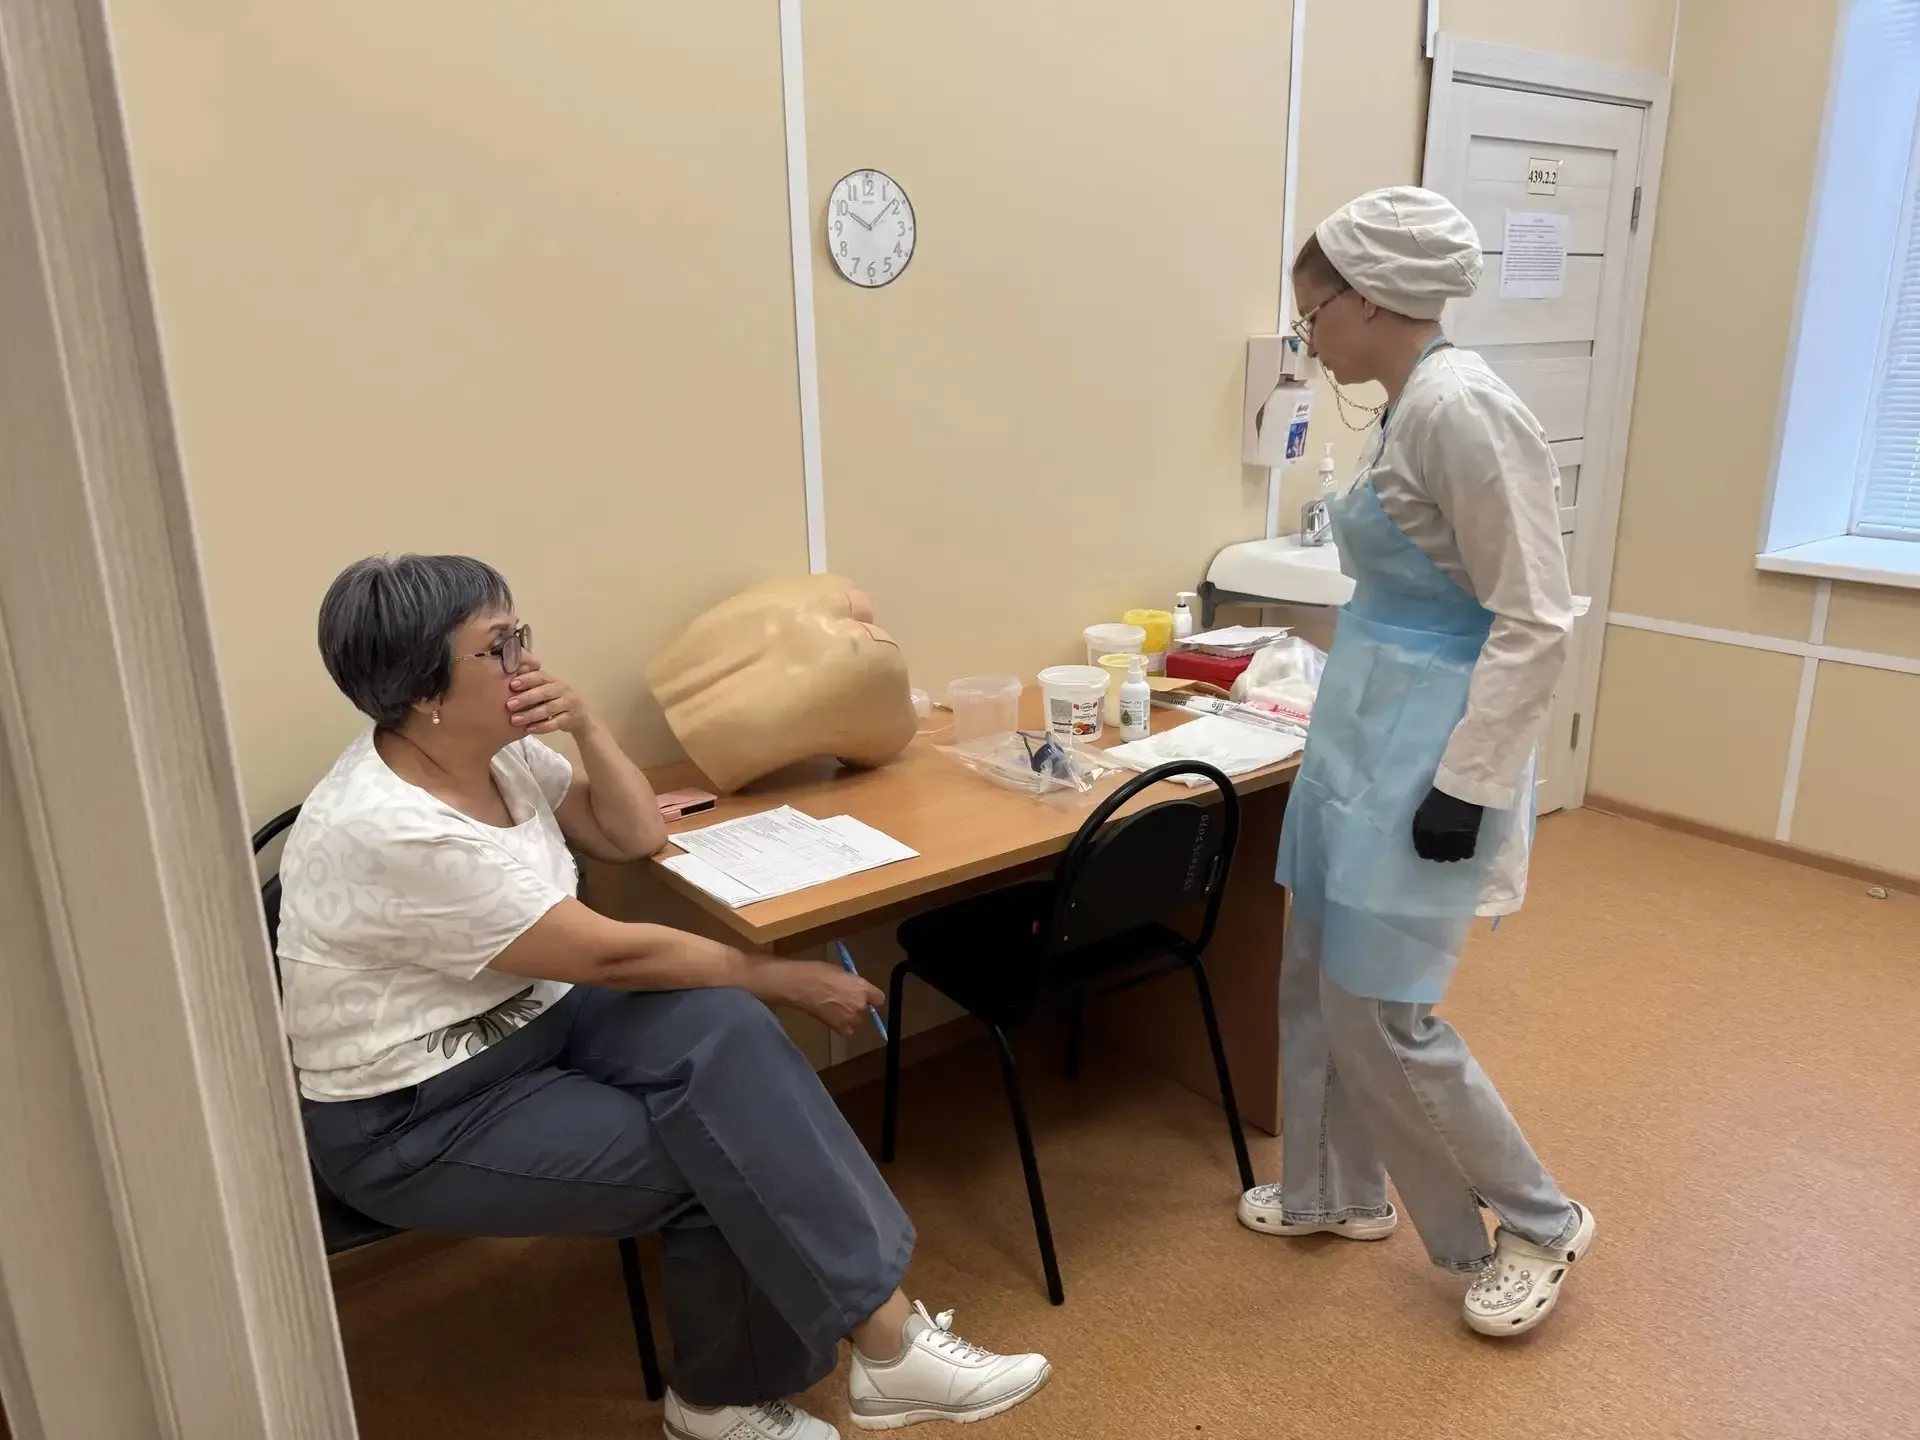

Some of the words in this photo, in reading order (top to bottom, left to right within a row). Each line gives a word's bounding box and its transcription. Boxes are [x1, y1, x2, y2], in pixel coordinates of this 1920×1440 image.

[1528, 169, 1556, 185] 439.2.2
[848, 184, 858, 201] 11
[862, 179, 875, 196] 12
[882, 184, 887, 201] 1
[836, 199, 849, 216] 10
[891, 199, 900, 216] 2
[834, 220, 843, 237] 9
[898, 220, 906, 237] 3
[840, 240, 848, 258] 8
[893, 240, 903, 258] 4
[852, 257, 861, 274] 7
[867, 261, 876, 278] 6
[883, 256, 892, 273] 5
[1211, 701, 1225, 711] life
